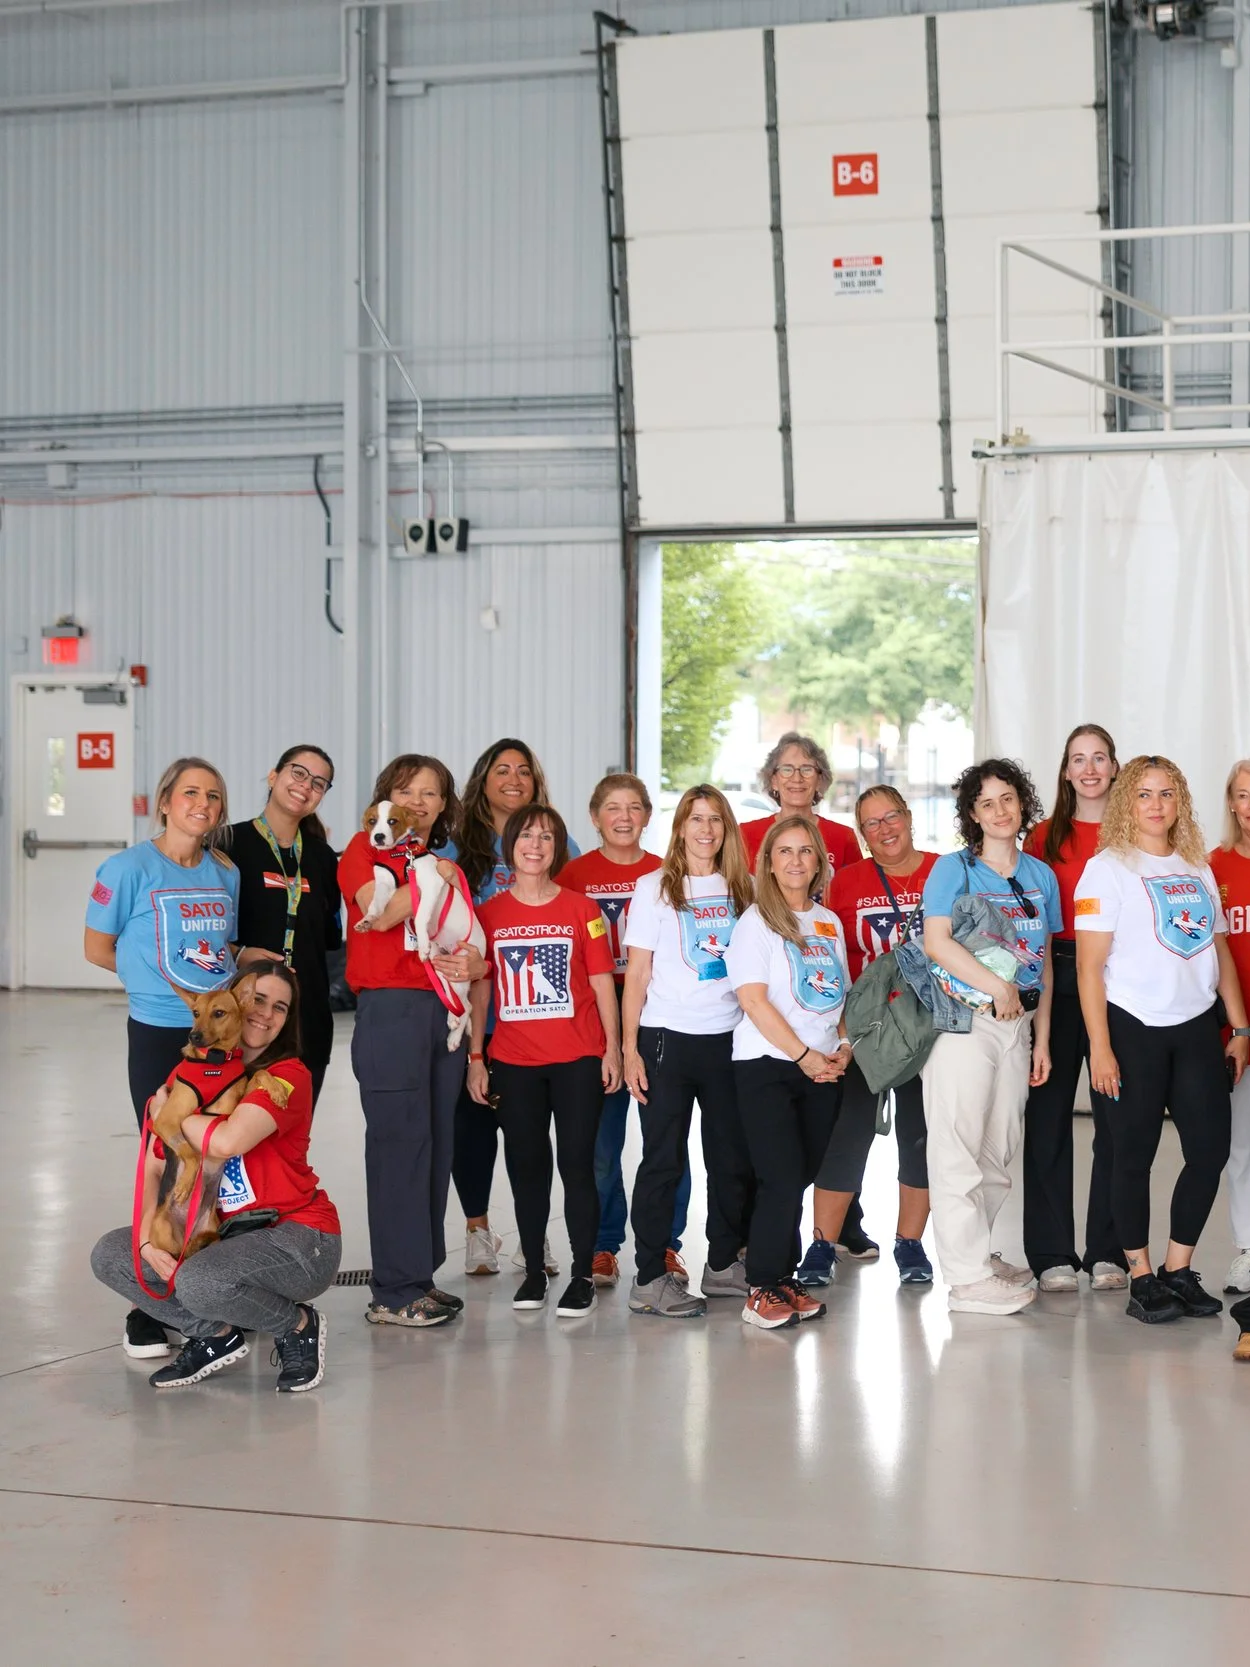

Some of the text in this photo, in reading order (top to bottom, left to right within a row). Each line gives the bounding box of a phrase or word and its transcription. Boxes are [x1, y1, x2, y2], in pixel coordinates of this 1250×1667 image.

[837, 161, 874, 185] B-6
[81, 739, 111, 760] B-5
[1162, 884, 1197, 895] SATO
[1167, 894, 1202, 904] UNITED
[179, 902, 225, 918] SATO
[693, 906, 728, 919] SATO
[181, 919, 227, 932] UNITED
[695, 919, 730, 928] UNITED
[1012, 919, 1043, 931] NITED
[493, 925, 574, 938] #SATOSTRONG
[801, 957, 834, 966] UNITED
[506, 1007, 547, 1015] OPERATION
